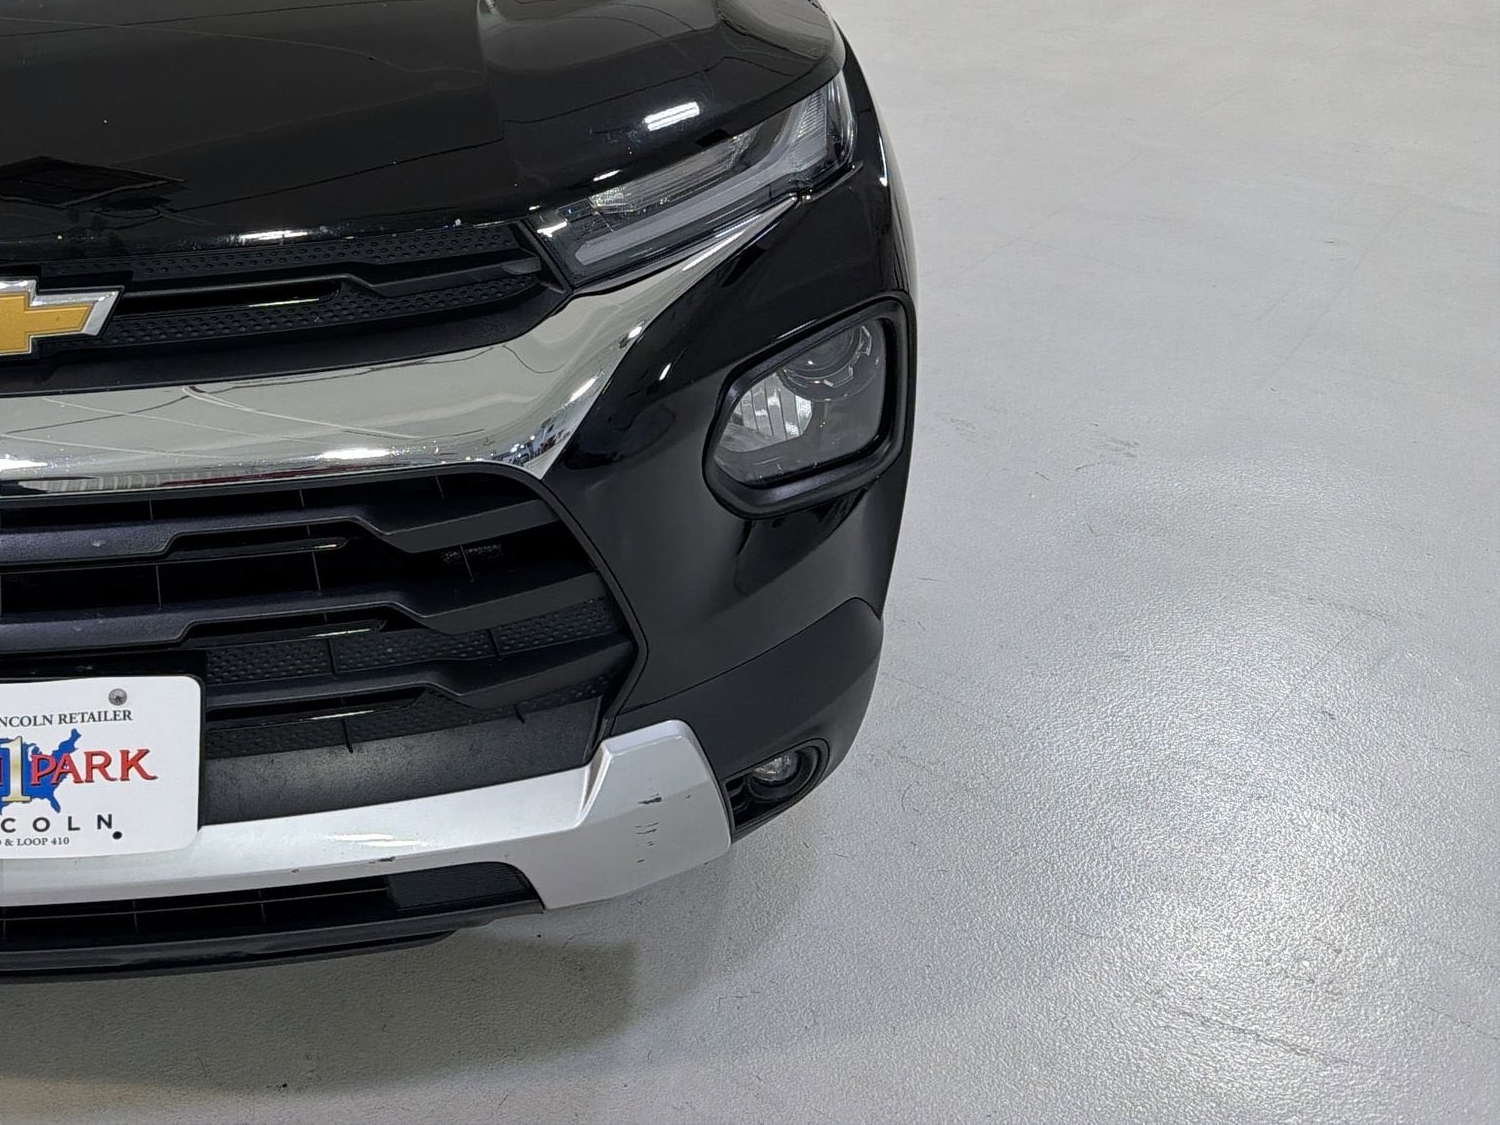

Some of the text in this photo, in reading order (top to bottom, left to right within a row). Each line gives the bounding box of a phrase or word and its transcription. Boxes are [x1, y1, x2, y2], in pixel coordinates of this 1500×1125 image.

[57, 709, 133, 725] RETAILER
[29, 748, 158, 787] PARK
[4, 838, 15, 847] &
[17, 837, 49, 847] LOOP
[51, 836, 70, 846] 410
